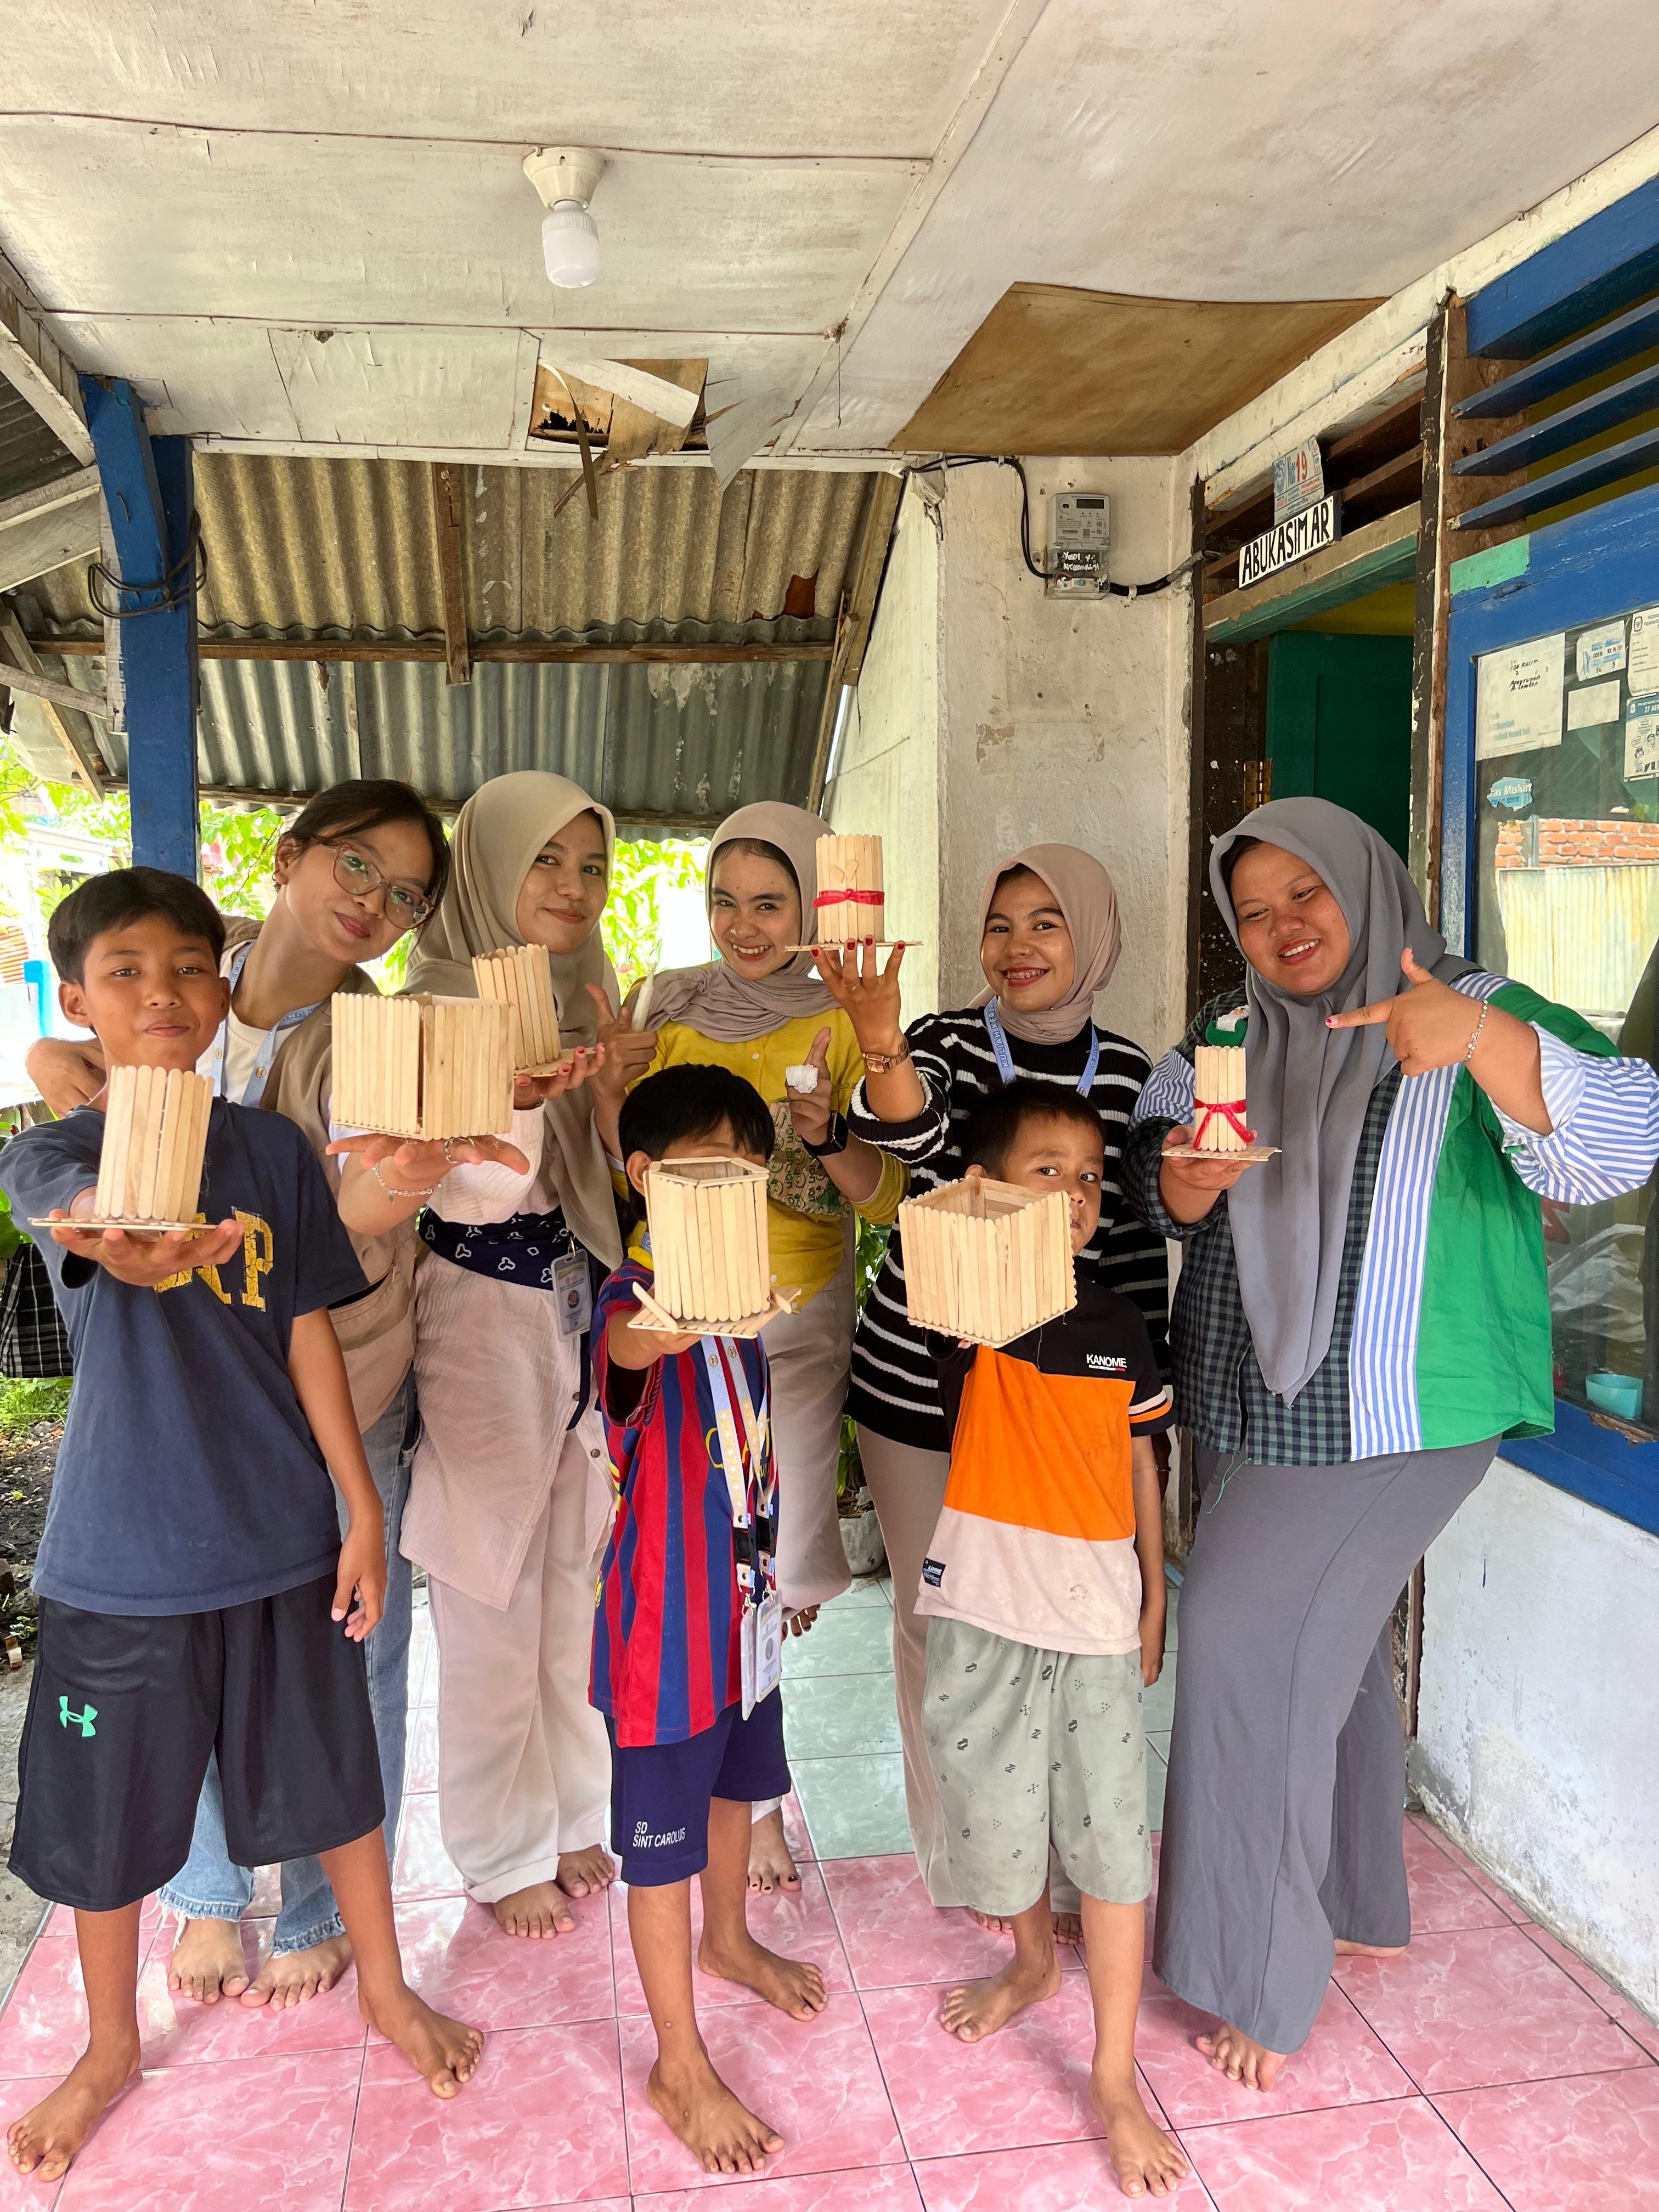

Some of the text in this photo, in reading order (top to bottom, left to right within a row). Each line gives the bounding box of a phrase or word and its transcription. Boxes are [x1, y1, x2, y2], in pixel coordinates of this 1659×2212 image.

[1296, 451, 1307, 482] 19
[1504, 783, 1532, 795] Miskin
[993, 1031, 1009, 1068] KULIAH
[1086, 1353, 1127, 1368] KANOME
[635, 1821, 648, 1835] SD
[633, 1827, 686, 1848] SINT CAROLUS
